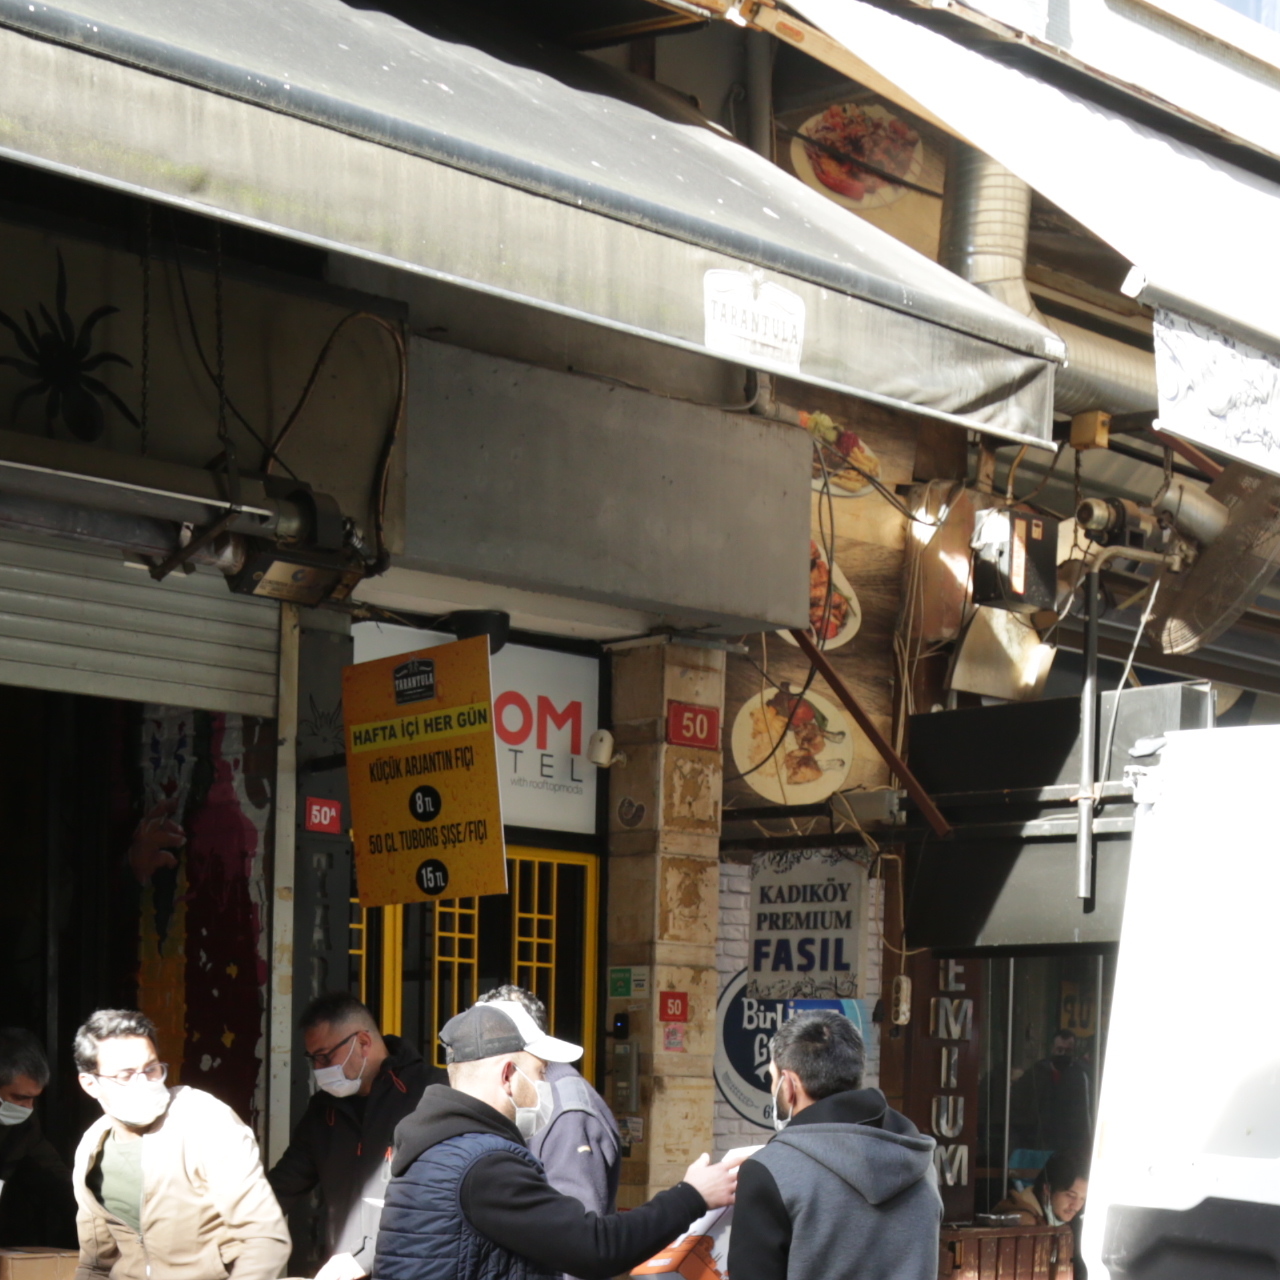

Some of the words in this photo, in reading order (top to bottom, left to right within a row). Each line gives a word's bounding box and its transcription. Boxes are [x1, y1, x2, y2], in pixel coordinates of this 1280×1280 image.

[711, 299, 798, 344] TARANTULA
[395, 672, 434, 692] TARANTULA
[353, 725, 398, 746] HAFTA
[401, 717, 420, 741] İÇİ
[424, 715, 453, 734] HER
[457, 707, 488, 729] GÜN
[682, 712, 708, 740] 50
[370, 755, 403, 784] KÜÇÜK
[455, 746, 475, 772] FIÇI
[510, 776, 529, 788] with
[415, 791, 424, 813] 8
[425, 797, 434, 812] TL
[369, 833, 383, 855] 50
[384, 832, 398, 853] CL
[398, 826, 439, 851] TUBORG
[421, 867, 434, 889] 15
[435, 873, 445, 887] TL
[759, 877, 852, 904] KADIKÖY
[756, 910, 853, 931] PREMIUM
[753, 937, 851, 972] FASIL
[667, 999, 682, 1016] 50
